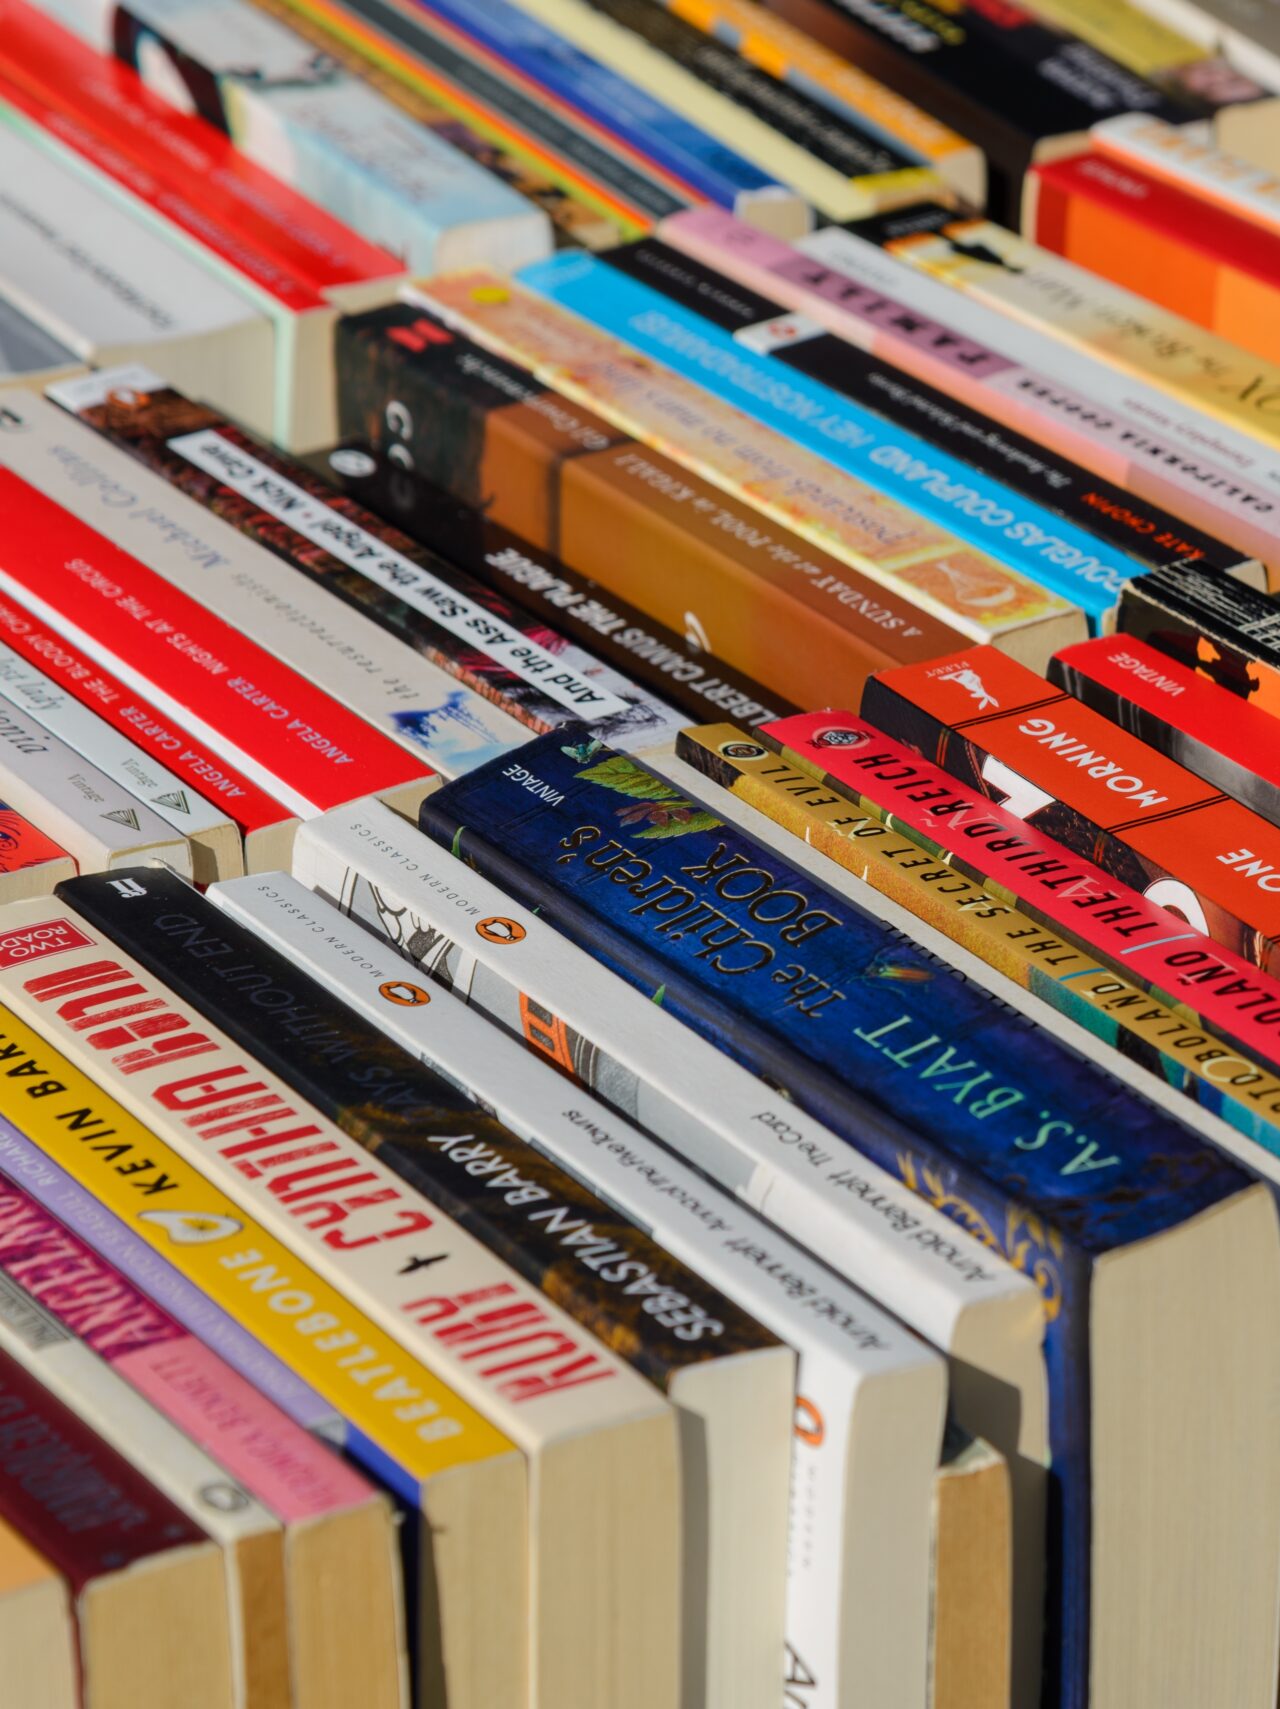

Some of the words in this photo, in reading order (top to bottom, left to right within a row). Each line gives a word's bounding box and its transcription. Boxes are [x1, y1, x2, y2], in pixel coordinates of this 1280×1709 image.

[198, 440, 260, 479] Cave
[249, 475, 301, 511] Nick
[869, 445, 1012, 532] COUPLAND
[309, 513, 386, 565] Angel
[710, 508, 772, 551] POOL
[64, 557, 121, 600] CIRCUS
[374, 552, 417, 585] the
[116, 592, 152, 622] THE
[414, 578, 470, 620] Saw
[567, 598, 623, 636] THE
[816, 576, 908, 639] SUNDAY
[146, 615, 174, 637] AT
[463, 616, 515, 648] Ass
[24, 633, 91, 680] BLOODY
[166, 632, 230, 677] NIGHTS
[508, 642, 548, 671] the
[620, 628, 707, 693] CAMUS
[1106, 651, 1186, 698] VINTAGE
[82, 676, 120, 705] THE
[227, 675, 290, 720] CARTER
[546, 666, 607, 705] And
[689, 680, 779, 729] LBERT
[118, 704, 180, 751] CARTER
[285, 715, 355, 765] ANGELA
[178, 747, 247, 799] ANGELA
[501, 762, 568, 808] VINTAGE
[759, 763, 837, 809] EVIL
[852, 752, 976, 818] REICH
[1017, 716, 1170, 810] MORNING
[348, 822, 421, 871] CLASSICS
[834, 814, 888, 841] OF
[963, 823, 1071, 891] THIRD
[418, 872, 481, 917] MODERN
[555, 825, 778, 977] Children's
[680, 841, 845, 950] BOOK
[879, 846, 1010, 922] SECRET
[256, 884, 325, 933] CLASSICS
[1070, 894, 1160, 939] THE
[0, 925, 69, 950] ROAD
[9, 936, 72, 958] TWO
[151, 912, 231, 961] END
[323, 933, 386, 979] MODERN
[1008, 924, 1081, 968] THE
[769, 963, 848, 1020] The
[22, 959, 222, 1076] BOND
[1090, 979, 1228, 1070] BOLAÑO
[853, 1014, 1027, 1122] BYATT
[54, 1106, 180, 1197] KEVIN
[561, 1108, 614, 1147] Towns
[750, 1110, 803, 1146] Card
[1012, 1109, 1121, 1178] A.S.
[151, 1064, 434, 1252] CYNTHIA
[426, 1133, 551, 1208] BARRY
[799, 1138, 834, 1169] The
[686, 1196, 735, 1232] Anna
[826, 1167, 915, 1234] Bennett
[527, 1205, 725, 1342] SEBASTIAN
[723, 1237, 815, 1302] Bennett
[912, 1223, 999, 1284] Arnold
[400, 1281, 619, 1404] RUBY
[804, 1287, 893, 1352] Arnold
[218, 1248, 465, 1443] BEATLEBONE
